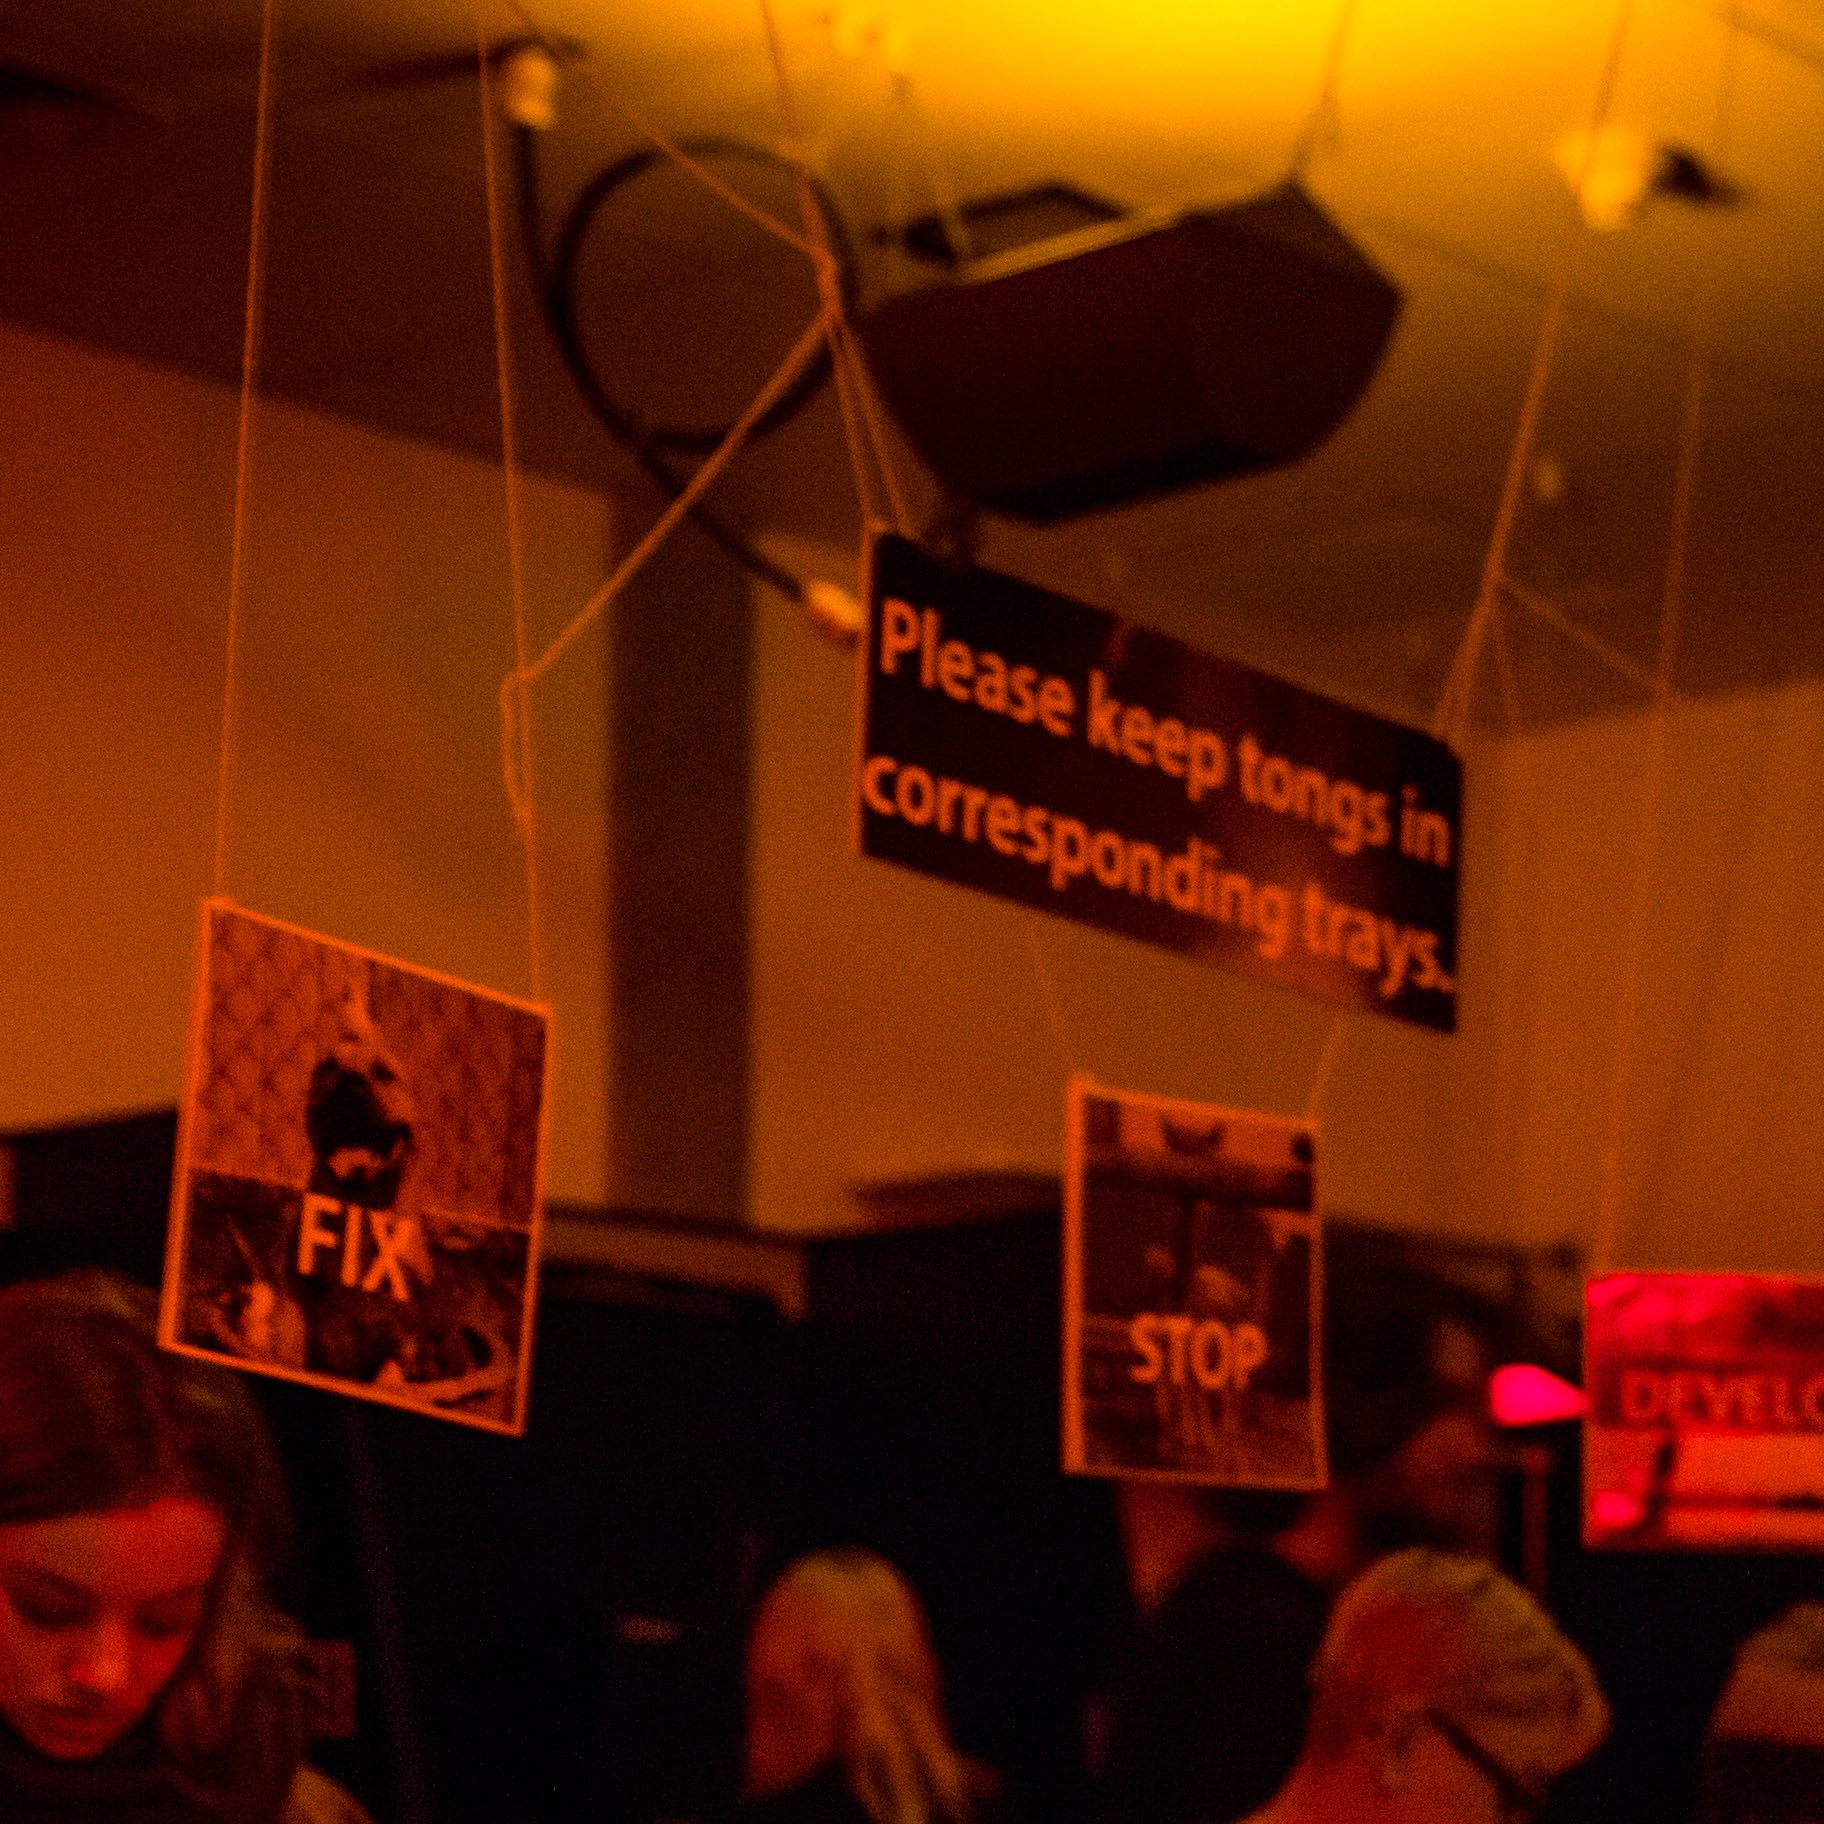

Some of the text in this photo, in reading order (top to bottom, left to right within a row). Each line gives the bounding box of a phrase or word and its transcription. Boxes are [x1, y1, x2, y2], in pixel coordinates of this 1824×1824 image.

[879, 596, 1452, 868] Please keep tongs in
[862, 754, 1455, 999] corresponding trays.
[296, 1190, 415, 1302] FIX
[1128, 1313, 1269, 1391] STOP
